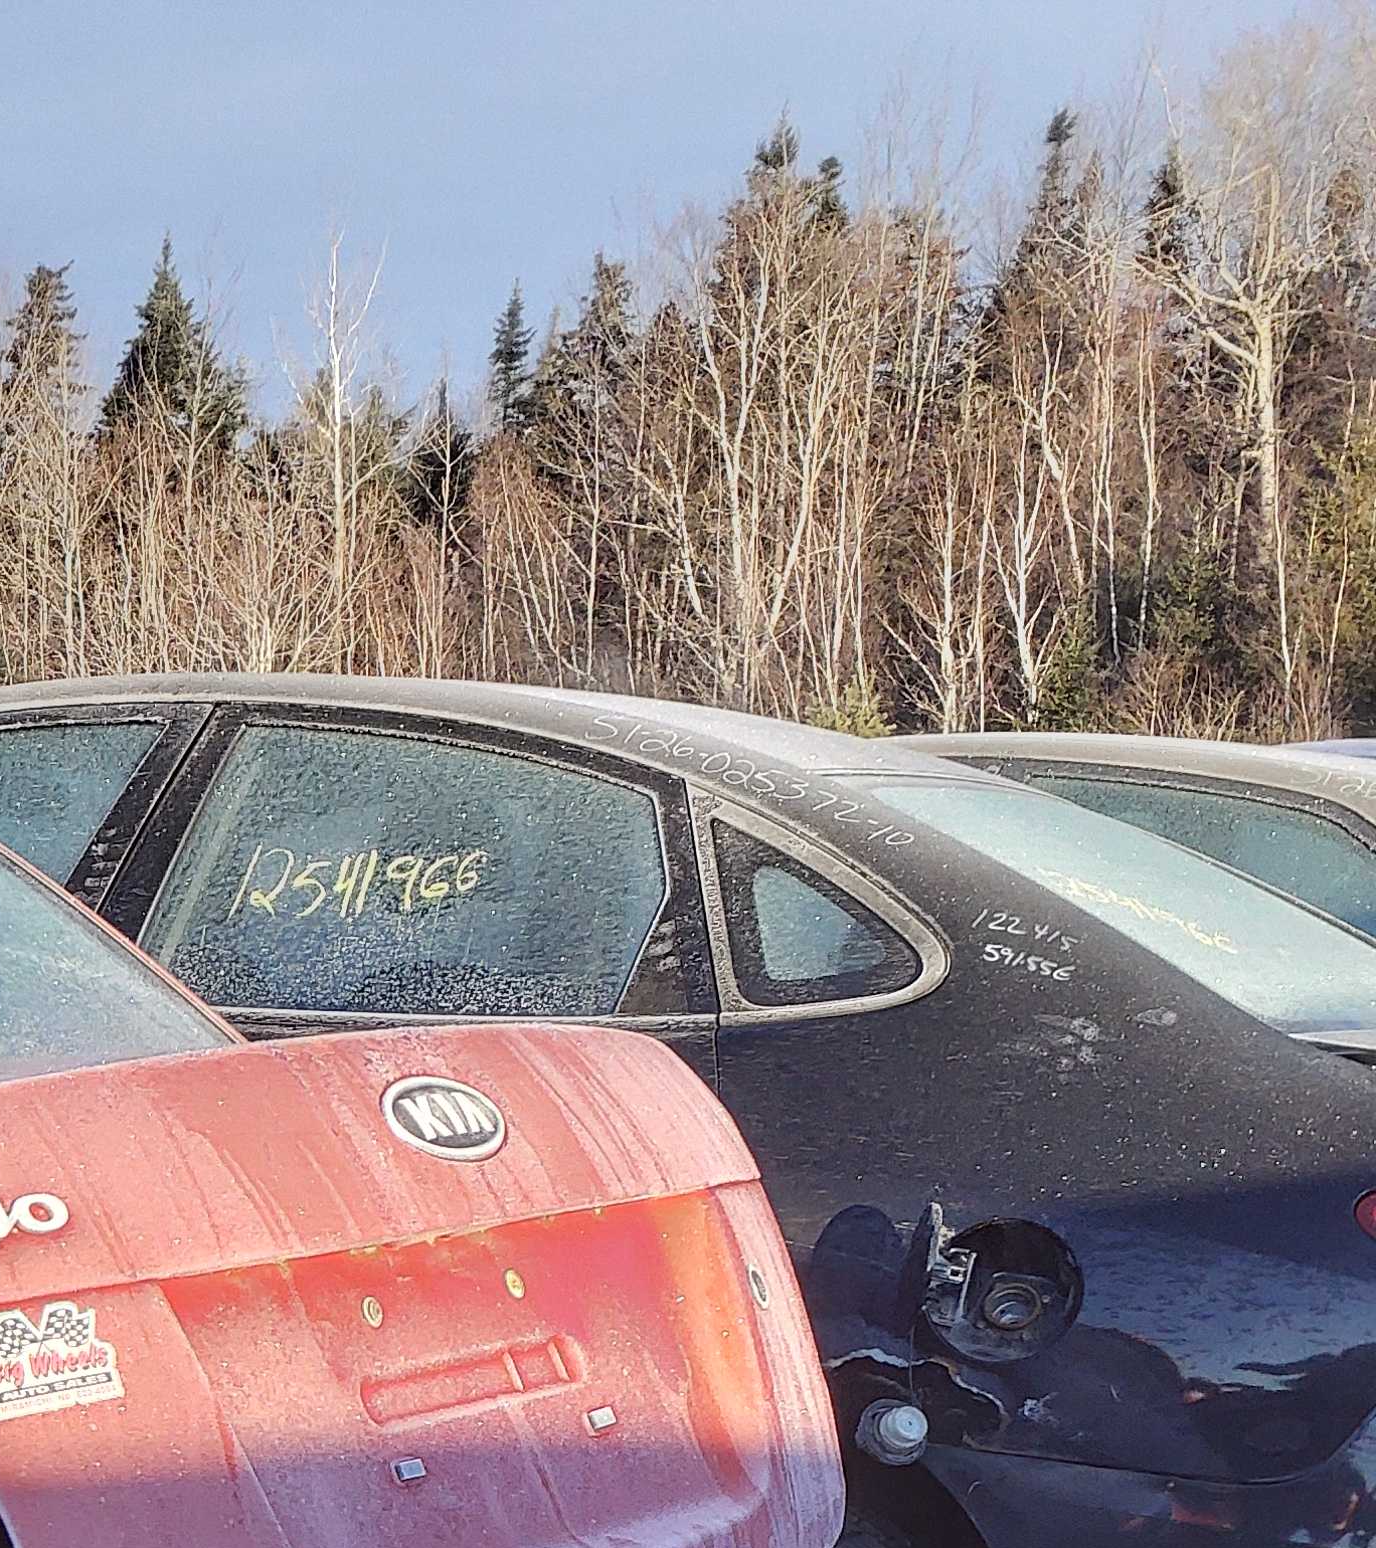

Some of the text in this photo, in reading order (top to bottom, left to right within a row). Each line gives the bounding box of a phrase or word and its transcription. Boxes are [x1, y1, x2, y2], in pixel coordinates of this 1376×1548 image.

[398, 1091, 497, 1141] KIA
[29, 1343, 109, 1379] Wheels
[0, 1373, 110, 1402] AUTO SALES
